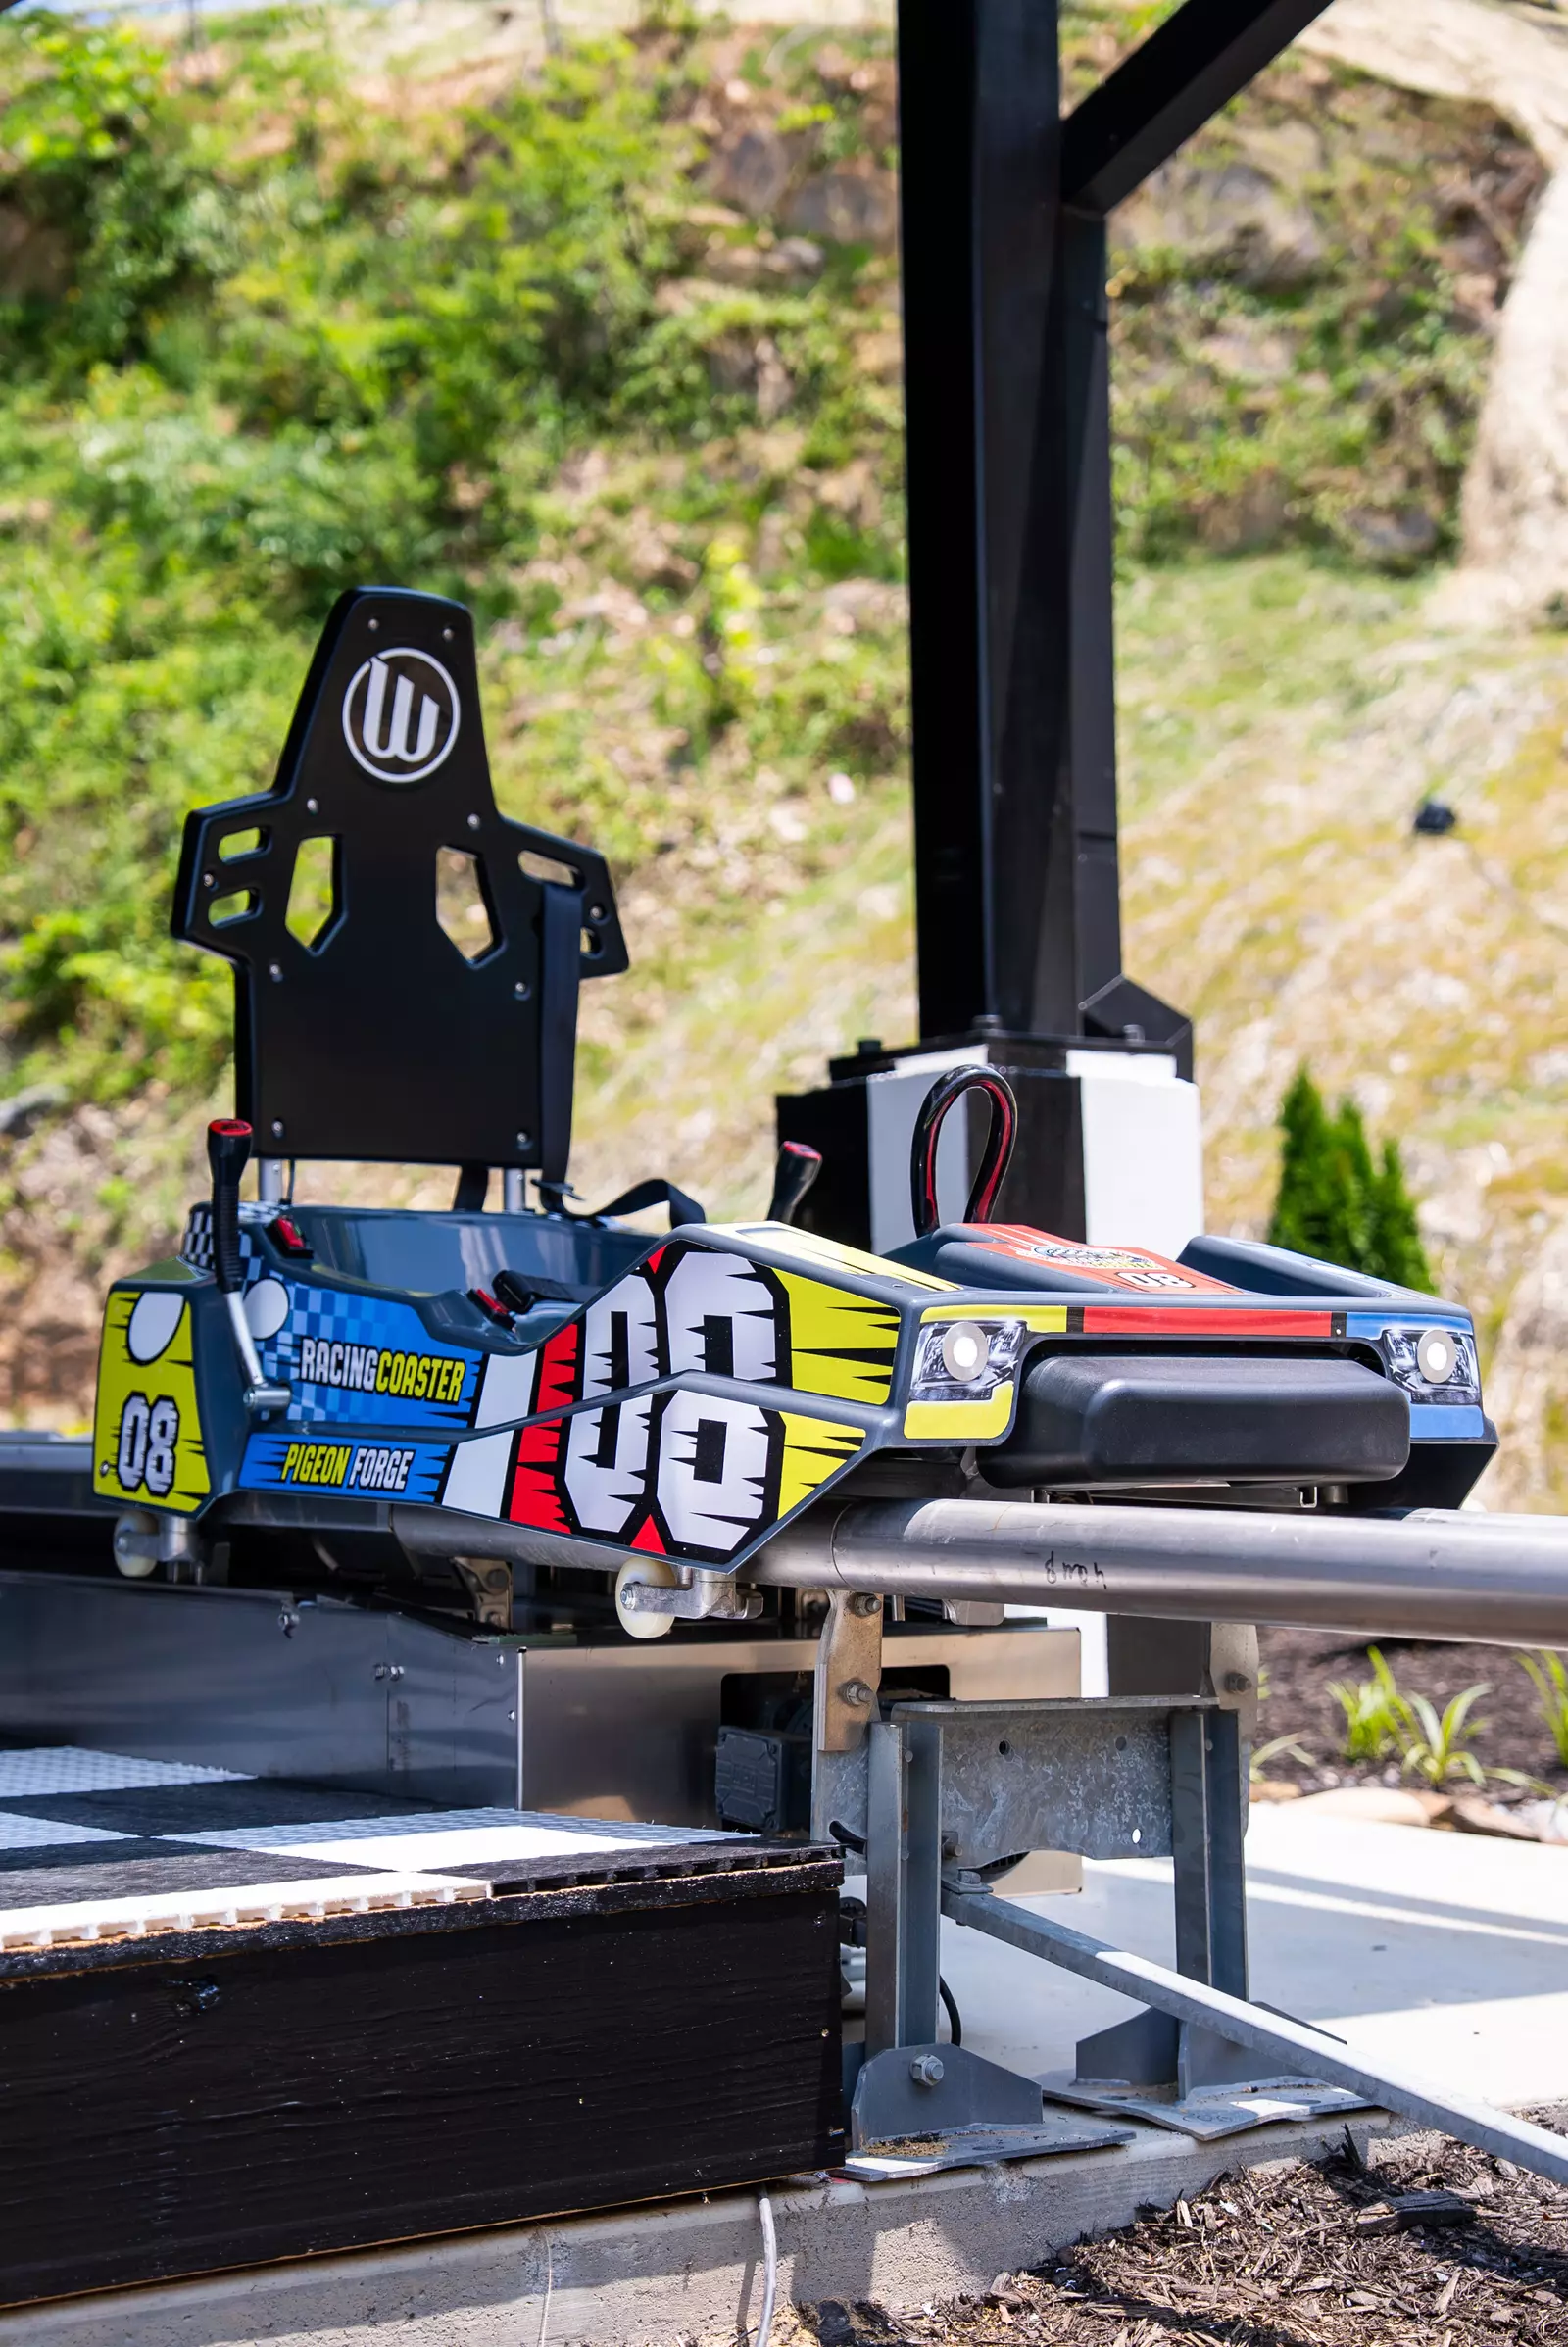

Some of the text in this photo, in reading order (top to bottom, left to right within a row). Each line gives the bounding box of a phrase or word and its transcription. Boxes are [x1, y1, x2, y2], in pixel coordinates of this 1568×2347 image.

[1116, 1272, 1196, 1289] 08
[119, 1394, 179, 1492] 08
[281, 1443, 415, 1490] PIGEON FORGE
